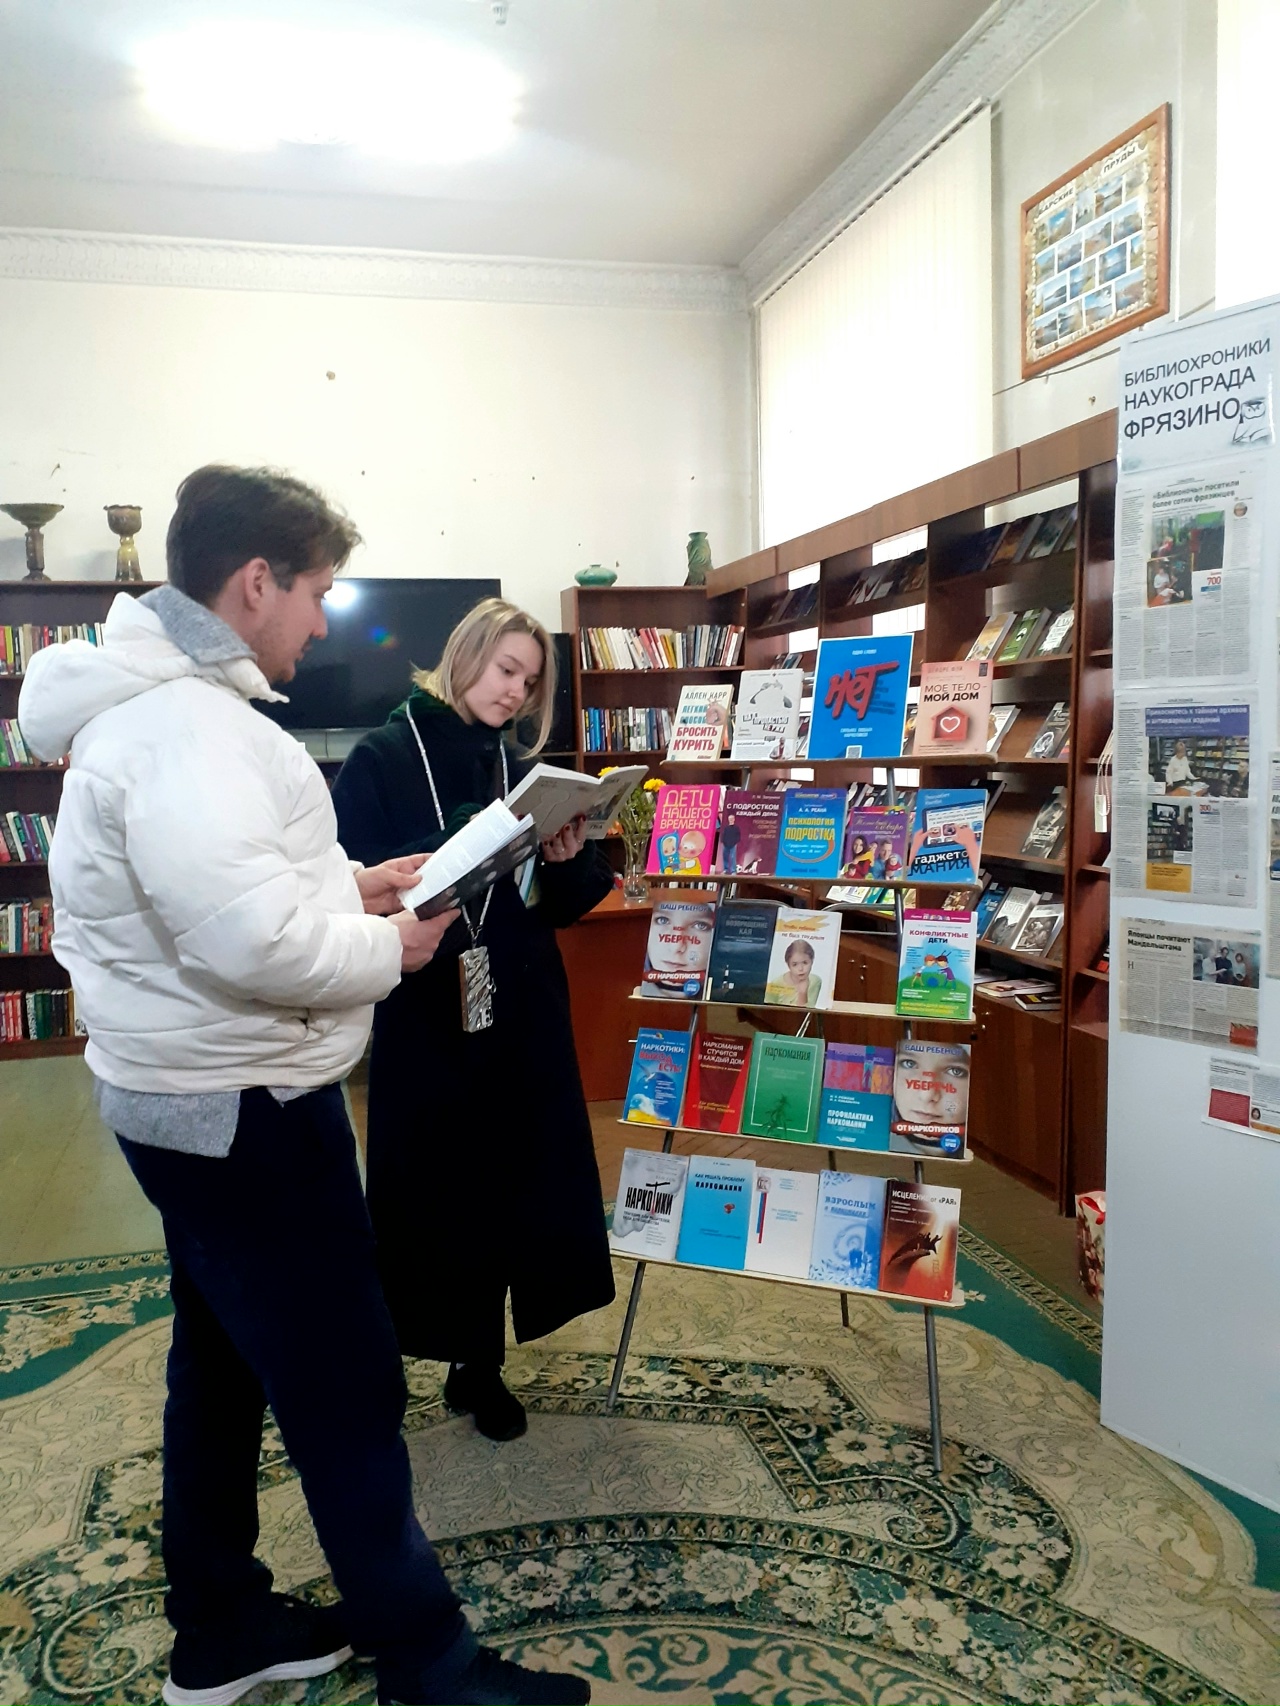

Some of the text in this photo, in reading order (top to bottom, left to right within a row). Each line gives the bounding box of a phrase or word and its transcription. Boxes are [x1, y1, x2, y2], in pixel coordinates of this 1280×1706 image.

[1040, 146, 1136, 214] АРСКИЕ ПРУДЫ
[1124, 337, 1271, 387] БИБЛИОХРОНИКИ
[1124, 365, 1256, 411] НАУКОГРАДА
[1124, 397, 1240, 440] ФРЯЗИНО
[1207, 577, 1222, 585] 700
[952, 683, 980, 692] ТЕЛО
[708, 691, 727, 699] КАРР
[924, 692, 979, 702] МОЙ ДОМ
[677, 727, 718, 737] БРОСИТЬ
[673, 740, 715, 751] КУРИТЬ
[663, 790, 714, 808] ДЕТИ
[733, 803, 780, 811] ПОДРОСТКОМ
[661, 807, 713, 819] НАШЕГО
[659, 819, 711, 830] ВРЕМЕНИ
[788, 817, 835, 826] ПСИХОЛОГИЯ
[784, 827, 836, 841] ПОДРОСТКА
[658, 934, 701, 945] УБЕРЕЧЬ
[909, 930, 969, 939] КОНФЛИКТНЫЕ
[1128, 930, 1191, 943] Японцы почитают
[1128, 938, 1182, 951] Мандельштама
[703, 1041, 744, 1051] НАРКОМАНИЯ
[905, 1044, 924, 1052] ВАШ
[706, 1049, 738, 1057] СТУЧИТСЯ
[765, 1047, 811, 1061] наркомания
[703, 1054, 729, 1064] КАЖДЫЙ
[905, 1079, 957, 1094] УБЕРЕЧЬ
[827, 1109, 874, 1122] ПРОФИЛАКТИКА
[826, 1117, 867, 1129] НАРКОМАНИИ
[908, 1125, 960, 1133] НАРКОТИКОВ
[695, 1181, 742, 1192] НАРКОМАНИИ
[625, 1181, 673, 1216] НАРКОТИКИ
[825, 1196, 877, 1209] ВЗРОСЛЫМ
